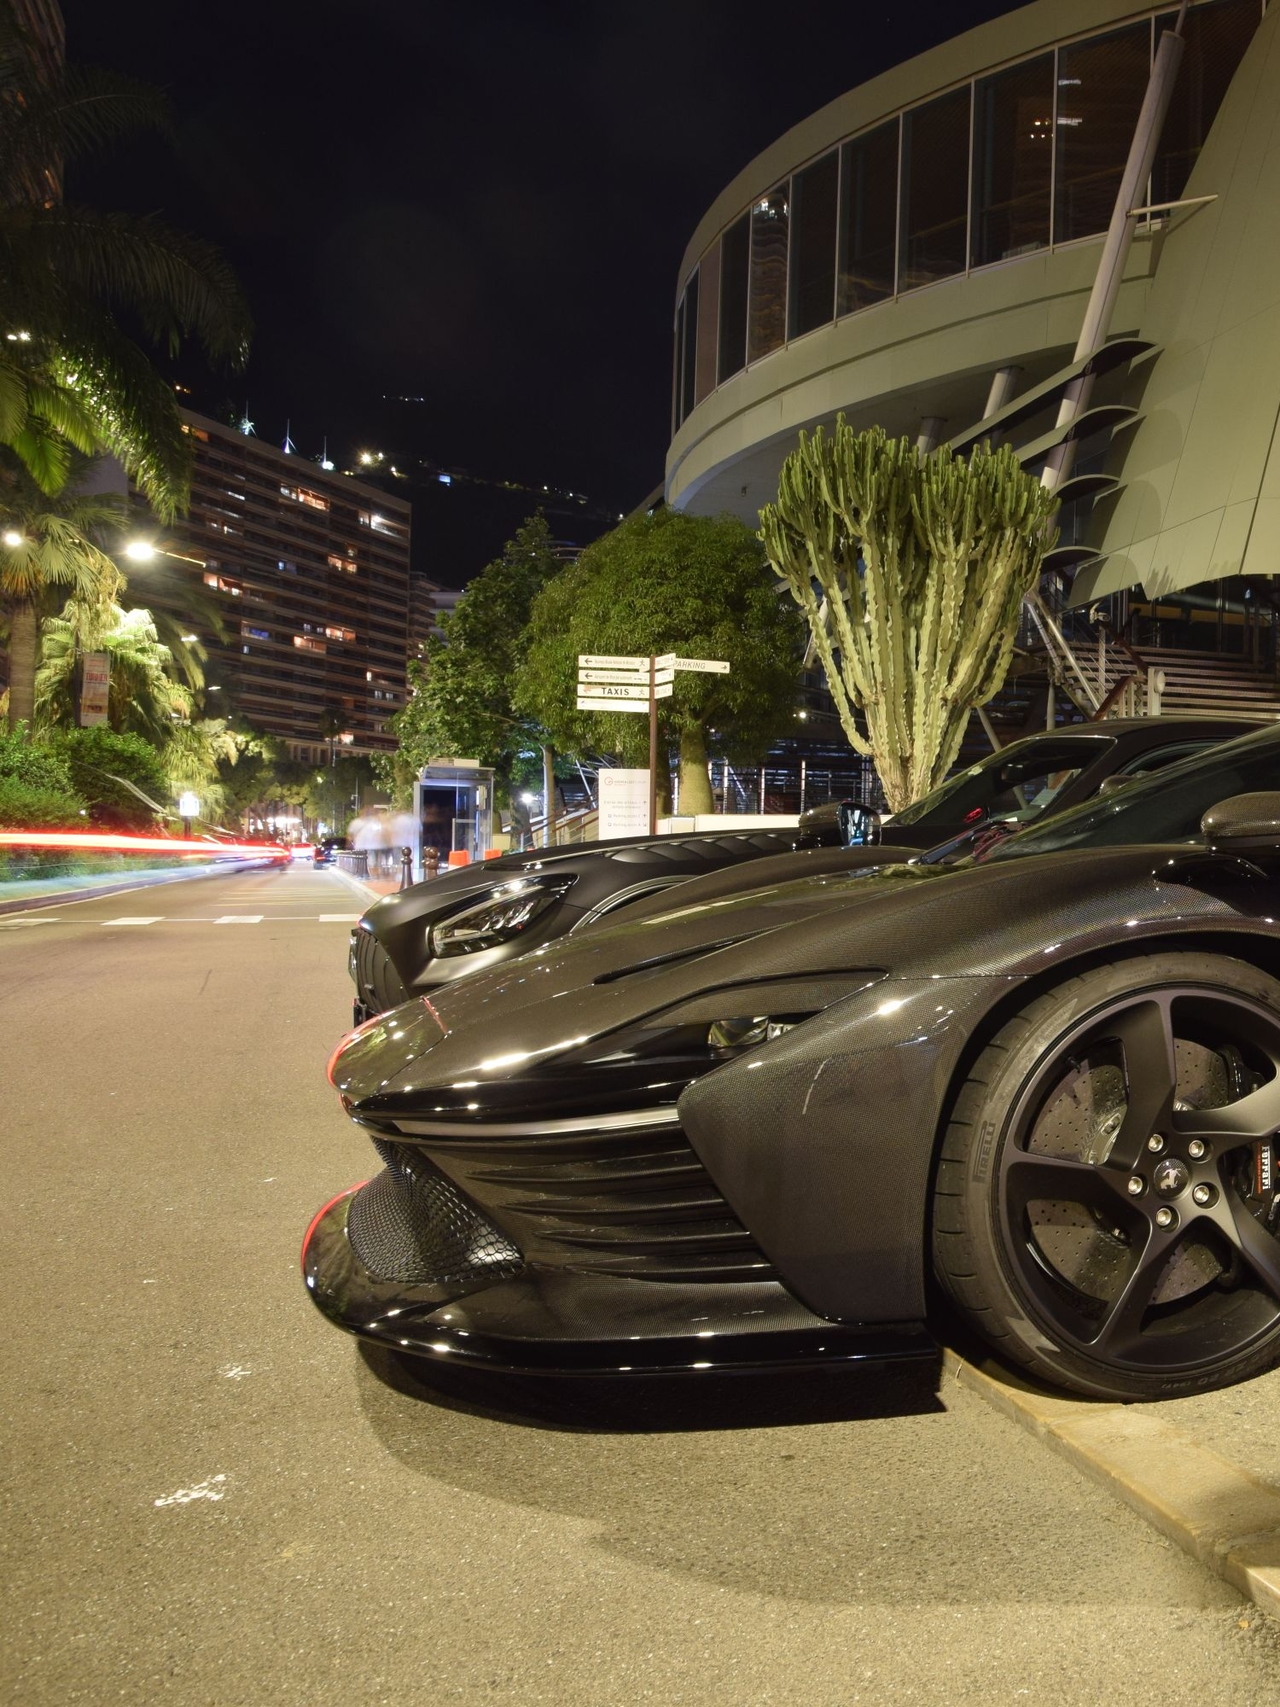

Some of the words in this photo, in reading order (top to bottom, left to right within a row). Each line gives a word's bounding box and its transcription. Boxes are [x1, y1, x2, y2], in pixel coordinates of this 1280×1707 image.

[673, 660, 706, 670] PARKING
[601, 687, 630, 696] TAXIS
[971, 1120, 997, 1184] PIRELLI
[1261, 1146, 1271, 1190] Ferrari
